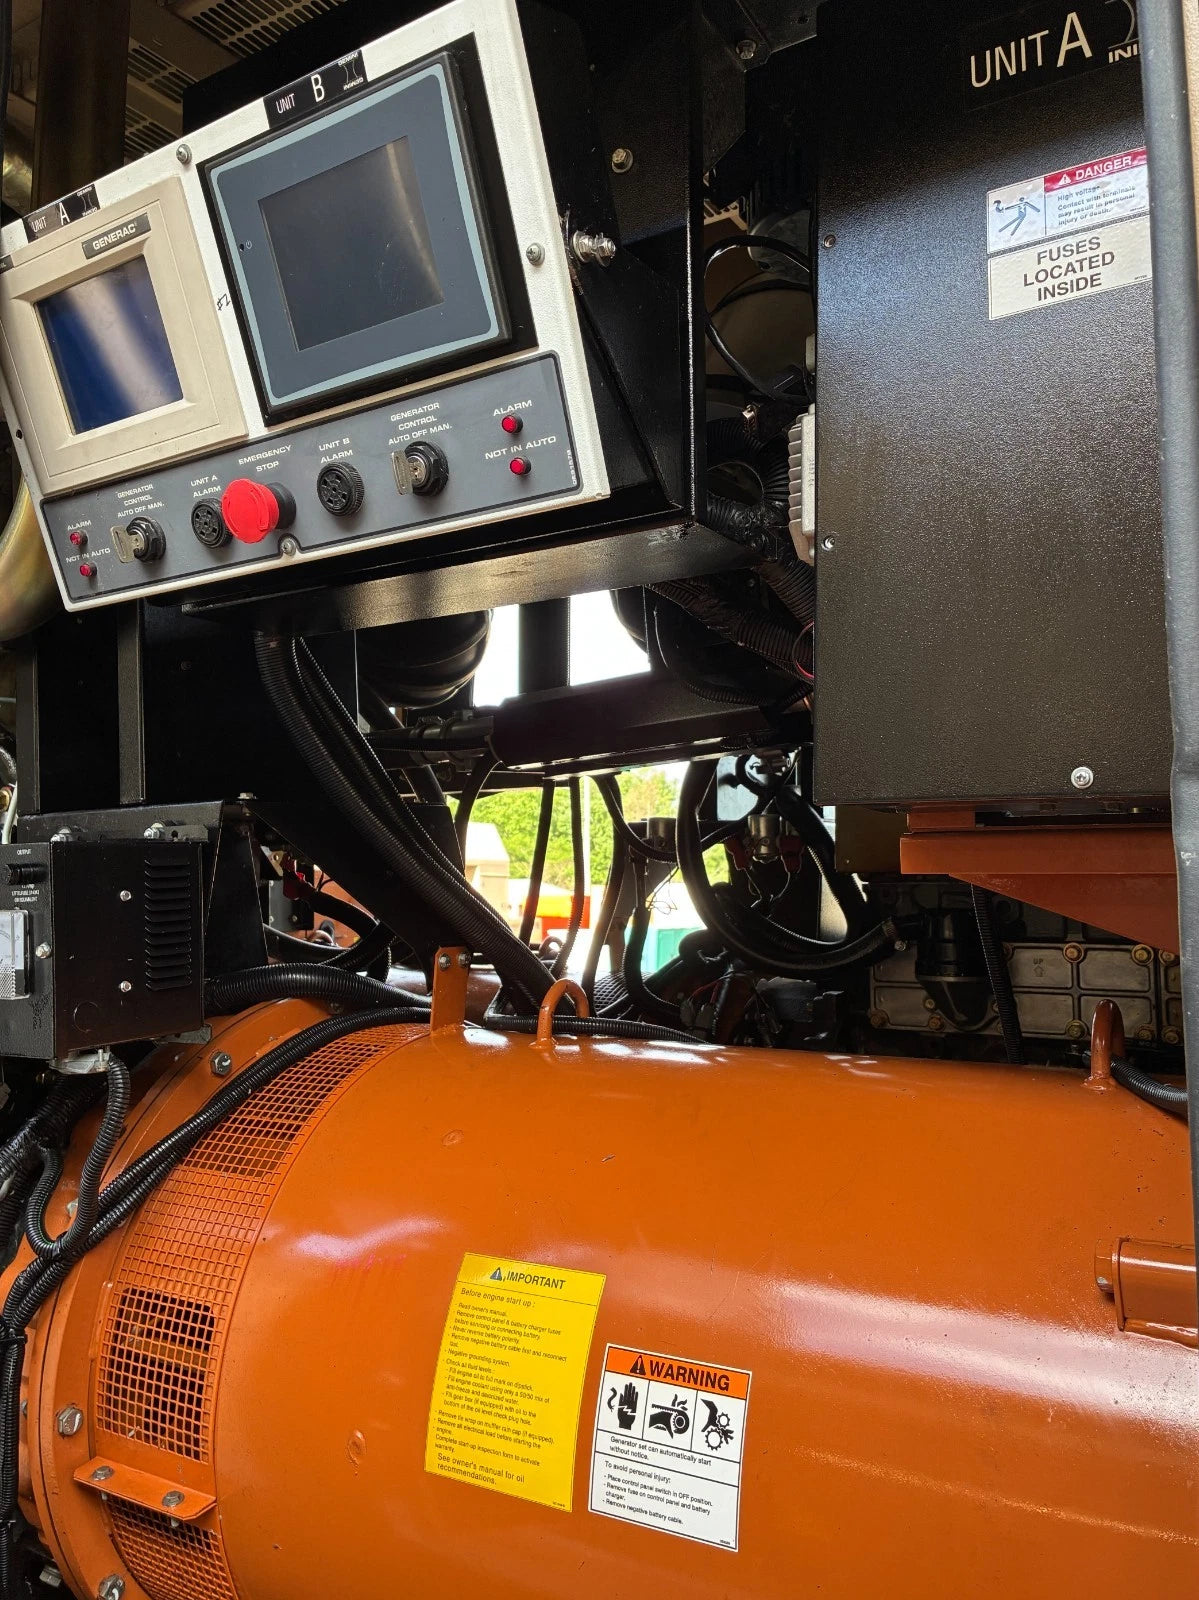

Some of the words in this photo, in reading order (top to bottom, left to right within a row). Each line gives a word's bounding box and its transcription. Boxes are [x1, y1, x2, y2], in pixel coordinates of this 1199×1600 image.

[970, 29, 1049, 88] UNIT
[1056, 11, 1092, 68] A
[276, 93, 295, 114] UNIT
[311, 73, 325, 102] B
[1075, 156, 1132, 180] DANGER
[1058, 199, 1084, 210] Contact
[30, 216, 48, 232] UNIT
[60, 202, 70, 226] A
[92, 224, 136, 250] GENERAC
[1036, 236, 1101, 265] FUSES
[1023, 251, 1115, 287] LOCATED
[1037, 273, 1102, 301] INSIDE
[390, 402, 440, 422] GENERATOR
[493, 400, 532, 416] ALARM
[398, 415, 438, 431] CONTROL
[318, 440, 340, 451] UNIT
[343, 437, 350, 445] B
[388, 434, 410, 446] AUTO
[412, 429, 428, 439] OFF
[429, 422, 453, 434] MAN.
[238, 444, 292, 466] EMERGENCY
[320, 449, 353, 464] ALARM
[485, 448, 508, 460] NOT
[511, 444, 522, 453] IN
[526, 436, 556, 450] AUTO
[256, 460, 279, 472] STOP
[117, 483, 154, 499] GENERATOR
[190, 477, 209, 487] UNIT
[192, 485, 221, 498] ALARM
[117, 510, 134, 518] AUTO
[148, 501, 165, 510] MAN.
[124, 494, 152, 506] CONTROL
[67, 519, 92, 531] ALARM
[66, 554, 80, 563] NOT
[91, 547, 111, 557] AUTO
[506, 1270, 566, 1290] IMPORTANT
[460, 1287, 481, 1297] Before
[482, 1292, 504, 1302] engine
[505, 1296, 521, 1305] start
[649, 1359, 730, 1391] WARNING
[609, 1444, 629, 1455] without
[630, 1450, 648, 1459] notice.
[610, 1436, 636, 1448] Generator
[659, 1448, 696, 1463] automatically
[697, 1456, 711, 1466] start
[437, 1452, 450, 1462] See
[452, 1456, 476, 1469] owner's
[478, 1464, 504, 1477] manual
[504, 1470, 514, 1480] for
[515, 1473, 524, 1482] oil
[437, 1462, 496, 1484] recommendations.
[613, 1462, 627, 1472] avoid
[628, 1467, 652, 1479] personal
[606, 1482, 626, 1492] Remove
[647, 1493, 664, 1502] control
[665, 1498, 679, 1507] panel
[691, 1504, 710, 1515] battery
[607, 1474, 620, 1482] Place
[621, 1477, 639, 1487] control
[654, 1486, 671, 1495] switch
[690, 1495, 712, 1506] position.
[605, 1498, 625, 1509] Remove
[648, 1510, 666, 1520] battery
